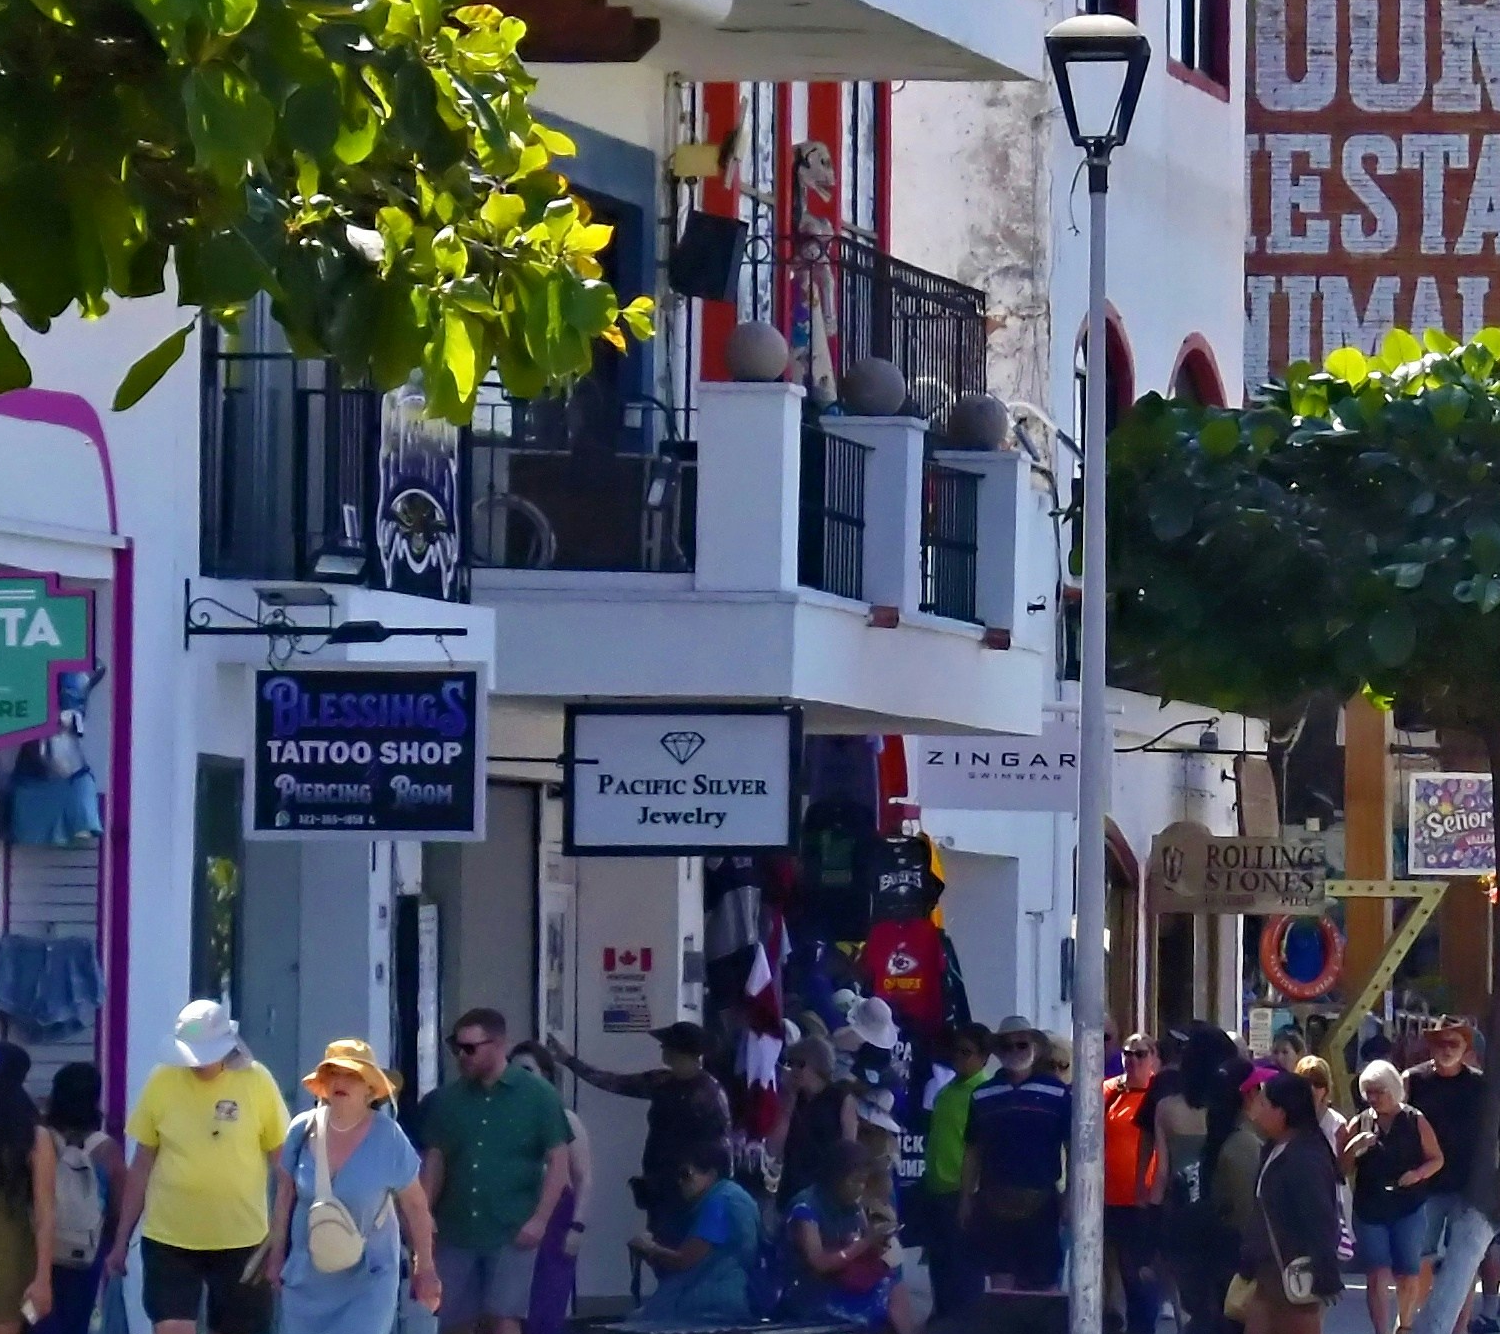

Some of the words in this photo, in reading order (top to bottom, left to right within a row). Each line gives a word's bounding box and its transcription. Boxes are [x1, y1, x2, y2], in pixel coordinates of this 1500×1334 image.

[266, 740, 372, 764] TATTOO
[379, 741, 462, 765] SHOP
[638, 806, 727, 829] Jewelry
[1426, 808, 1492, 839] Señor
[1206, 844, 1318, 869] ROLLING
[1206, 871, 1315, 894] STONES
